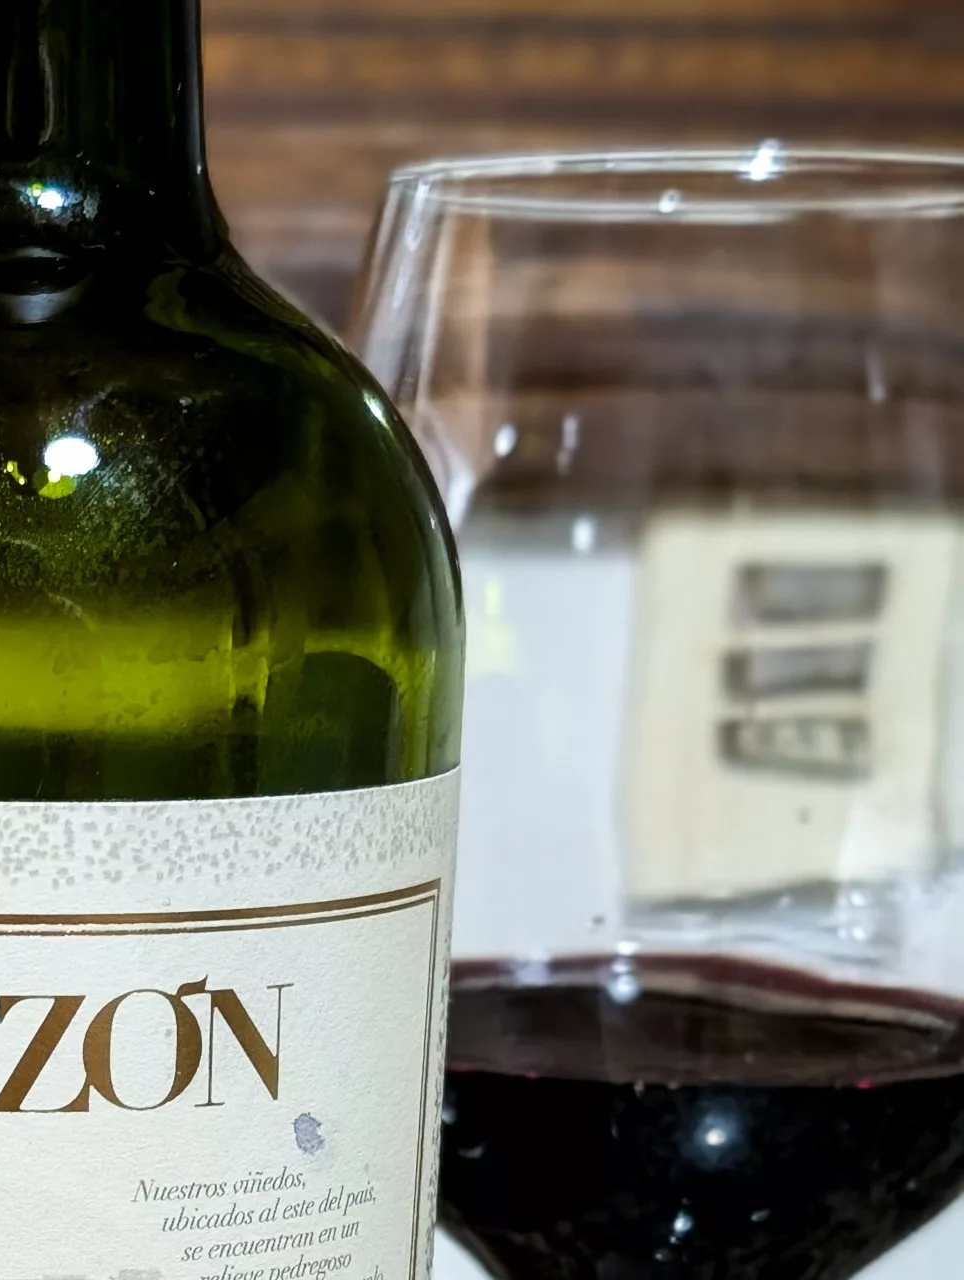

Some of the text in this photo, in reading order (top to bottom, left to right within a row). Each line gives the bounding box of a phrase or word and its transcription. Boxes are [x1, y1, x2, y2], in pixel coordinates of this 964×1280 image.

[131, 1166, 306, 1203] Nuestros viñedos,
[162, 1203, 253, 1232] ubicados
[259, 1197, 280, 1223] al
[283, 1200, 315, 1221] este
[319, 1185, 344, 1214] del
[181, 1220, 360, 1262] se encuentran en un
